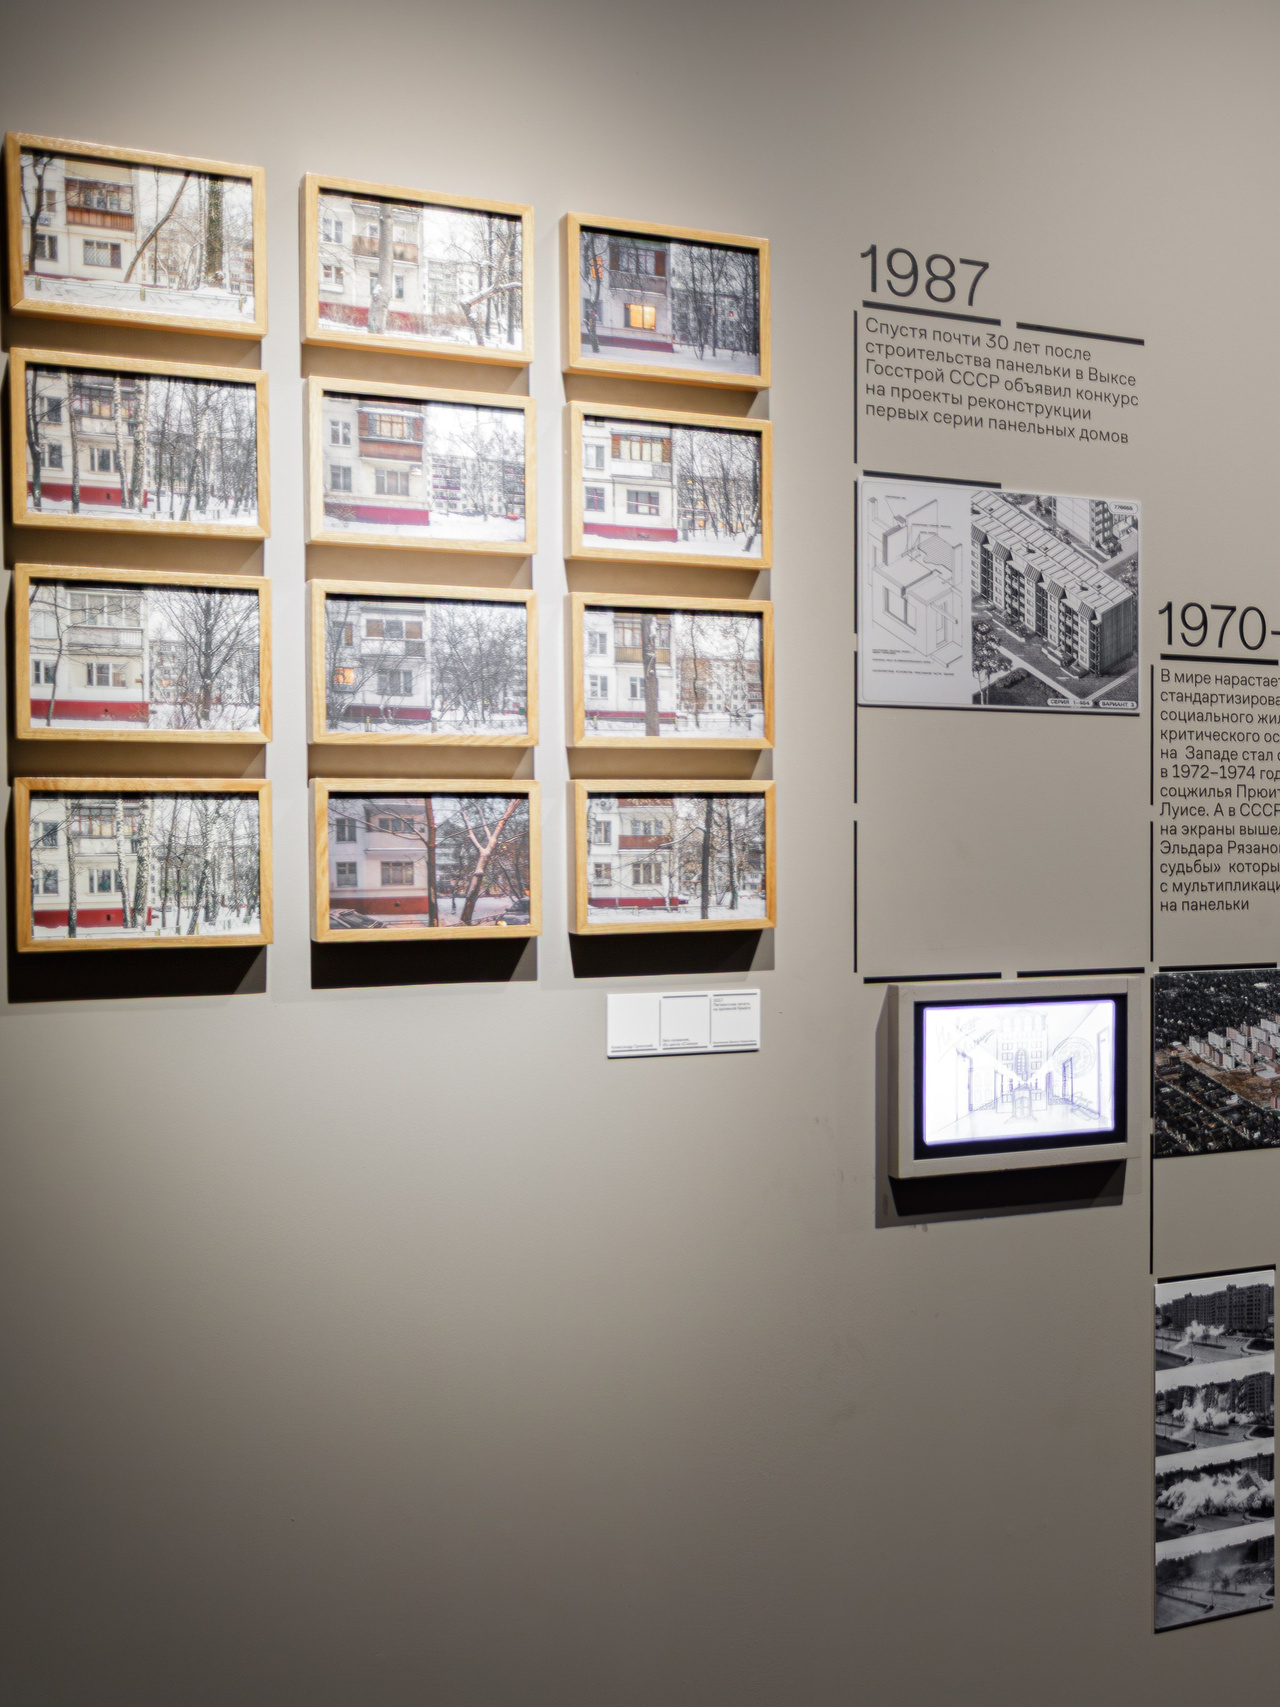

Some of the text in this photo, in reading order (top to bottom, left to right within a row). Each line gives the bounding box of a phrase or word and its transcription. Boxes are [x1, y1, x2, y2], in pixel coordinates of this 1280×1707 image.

[860, 244, 990, 306] 1987
[866, 317, 1091, 361] Спустя почти 30 лет после
[865, 342, 1136, 386] строительства панельки в Выксе
[866, 358, 1138, 408] Госстрой СССР объявил конкурс
[866, 383, 1091, 421] на проекты реконструкции
[866, 404, 1128, 444] первых серии панельных домов
[1161, 668, 1171, 683] В
[1174, 672, 1211, 687] мире
[1160, 710, 1254, 724] социального
[1160, 729, 1260, 743] критического
